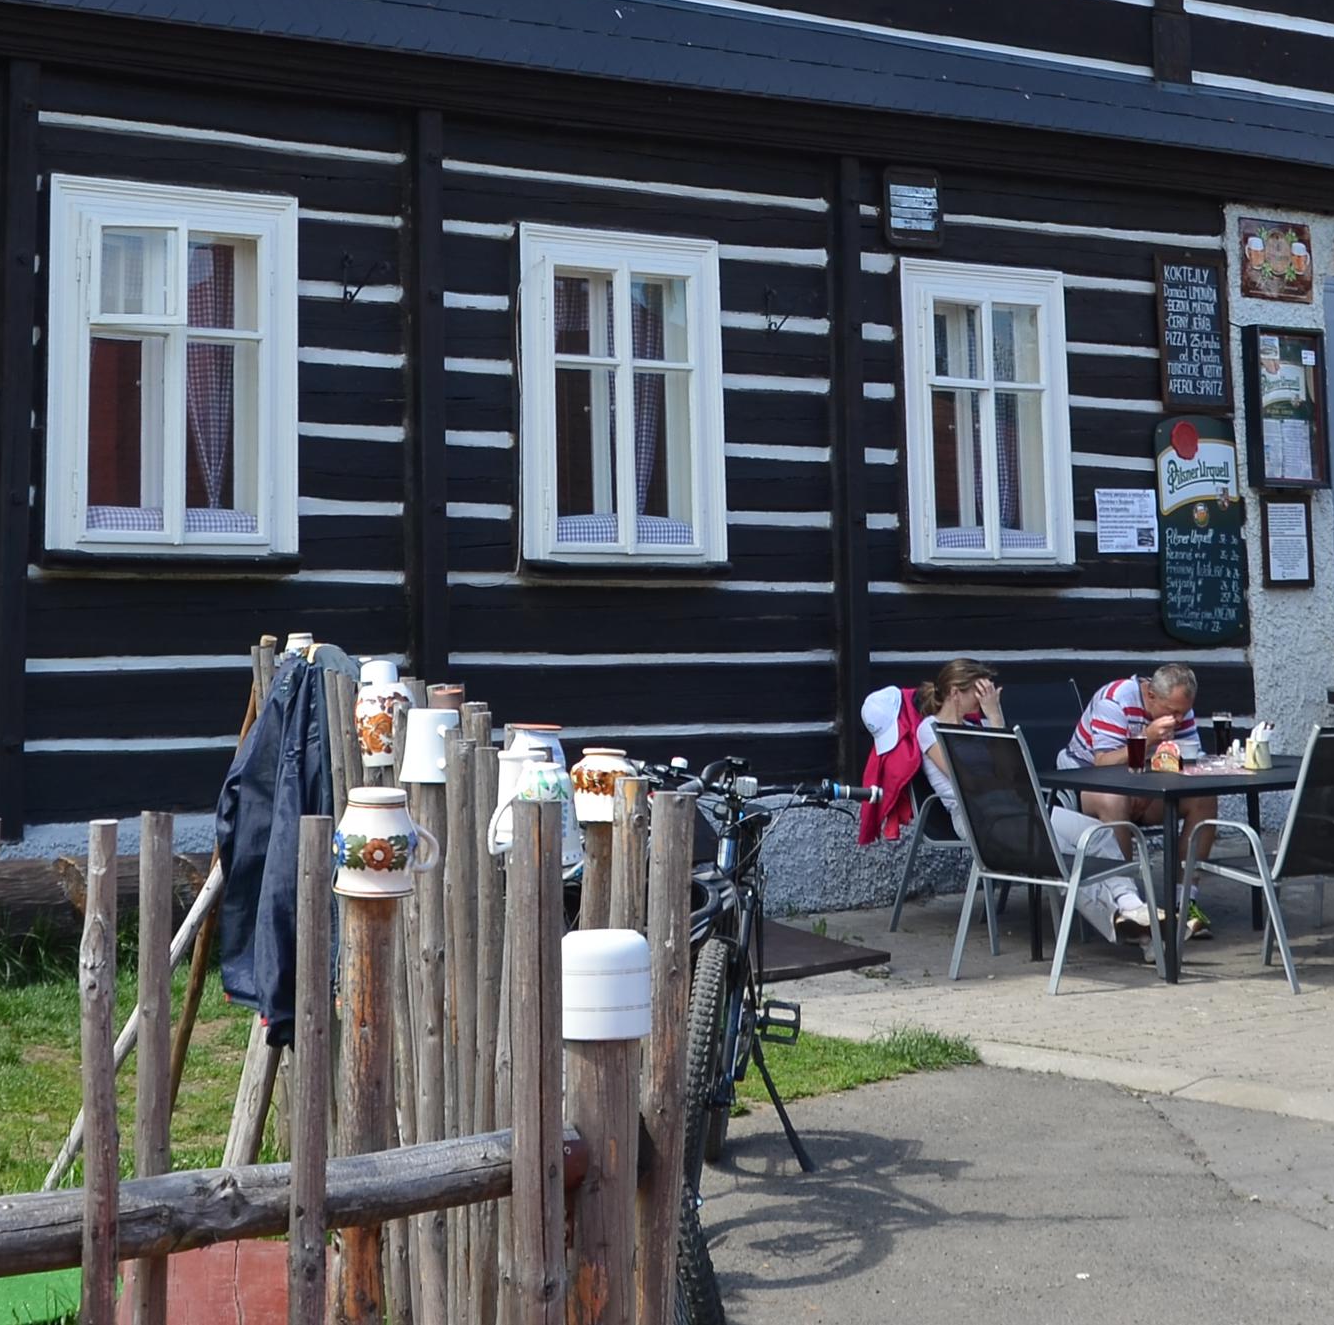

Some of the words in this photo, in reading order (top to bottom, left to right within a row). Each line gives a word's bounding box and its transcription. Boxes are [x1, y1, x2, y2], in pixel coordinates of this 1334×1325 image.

[1163, 265, 1209, 284] KOKTEJLY
[1165, 331, 1188, 346] PIZZA
[1190, 333, 1201, 347] 25
[1179, 348, 1189, 362] od
[1169, 378, 1195, 394] APEROL
[1196, 380, 1223, 396] SPRITZ
[1167, 459, 1199, 494] Pilsner
[1198, 458, 1230, 485] Urquell
